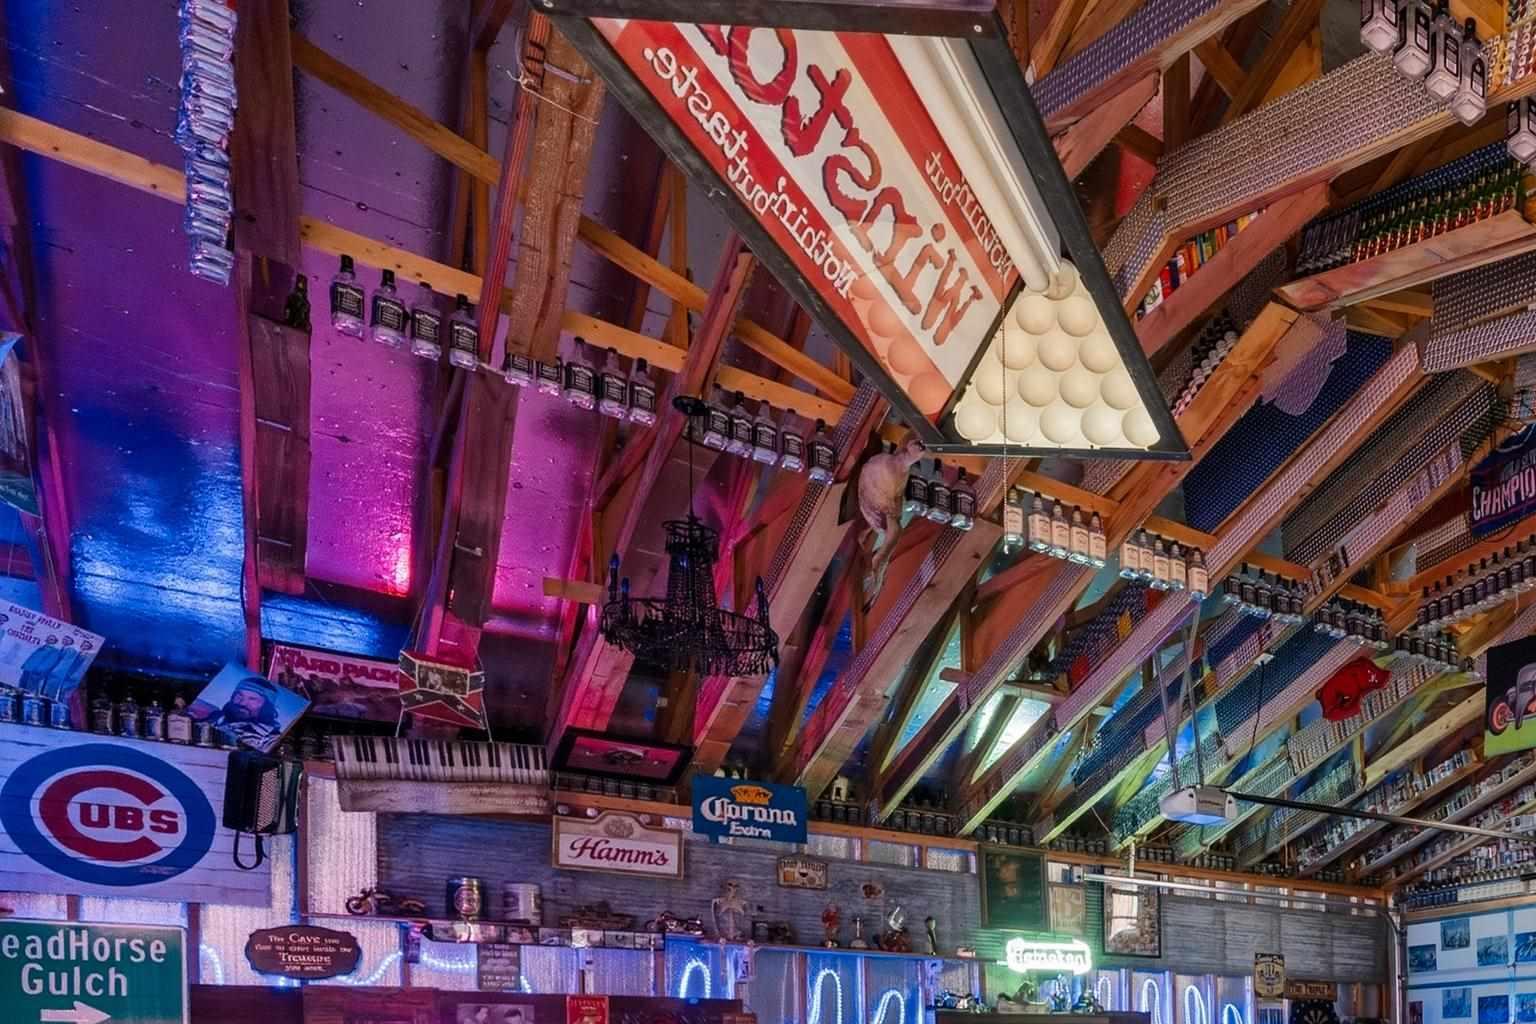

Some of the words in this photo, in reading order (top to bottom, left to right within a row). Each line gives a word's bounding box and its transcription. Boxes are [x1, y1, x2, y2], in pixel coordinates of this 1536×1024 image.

[38, 769, 180, 863] CUBS
[700, 795, 798, 827] Corona
[728, 820, 772, 840] Extra
[567, 837, 670, 866] Hamm's
[20, 962, 129, 997] Gulch
